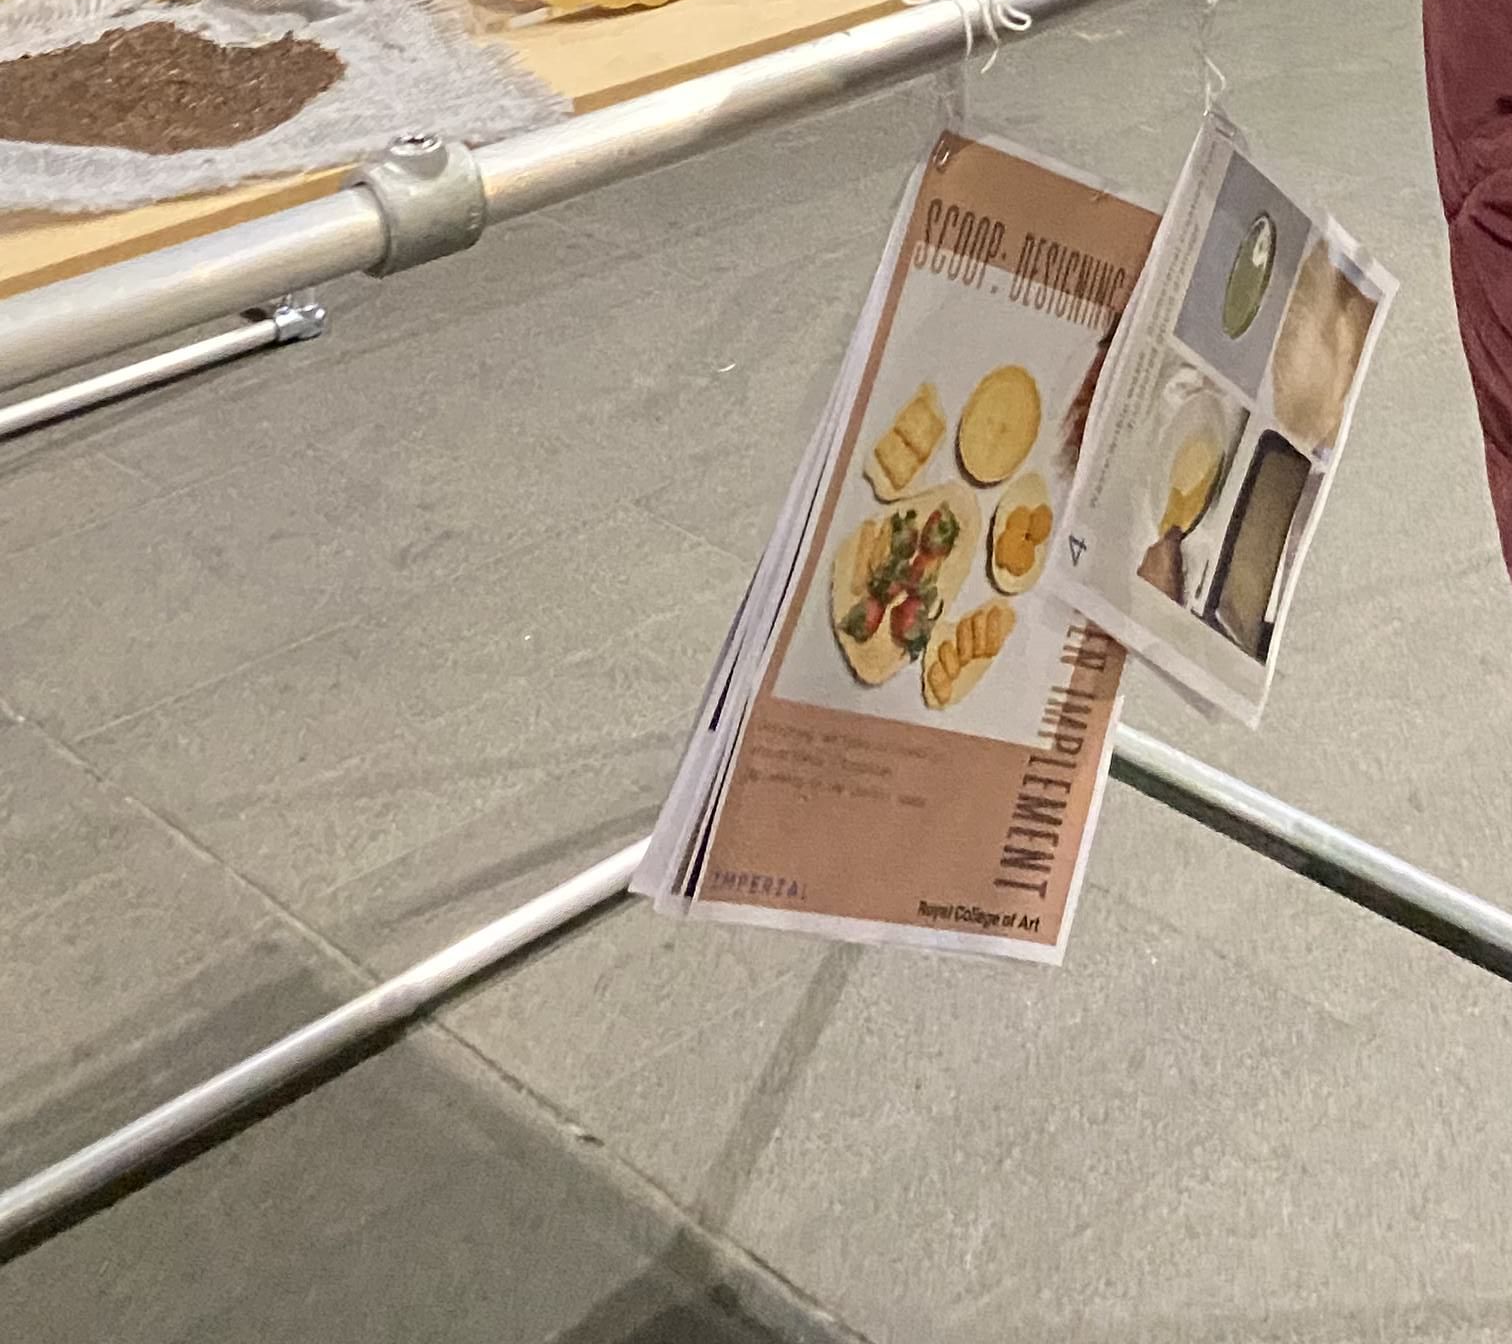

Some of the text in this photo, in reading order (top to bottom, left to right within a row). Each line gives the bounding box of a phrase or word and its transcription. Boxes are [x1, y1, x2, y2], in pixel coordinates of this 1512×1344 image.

[1008, 231, 1126, 331] DESIGNING
[993, 685, 1096, 900] IMPLEMENT
[918, 900, 1040, 933] Royal College of Art
